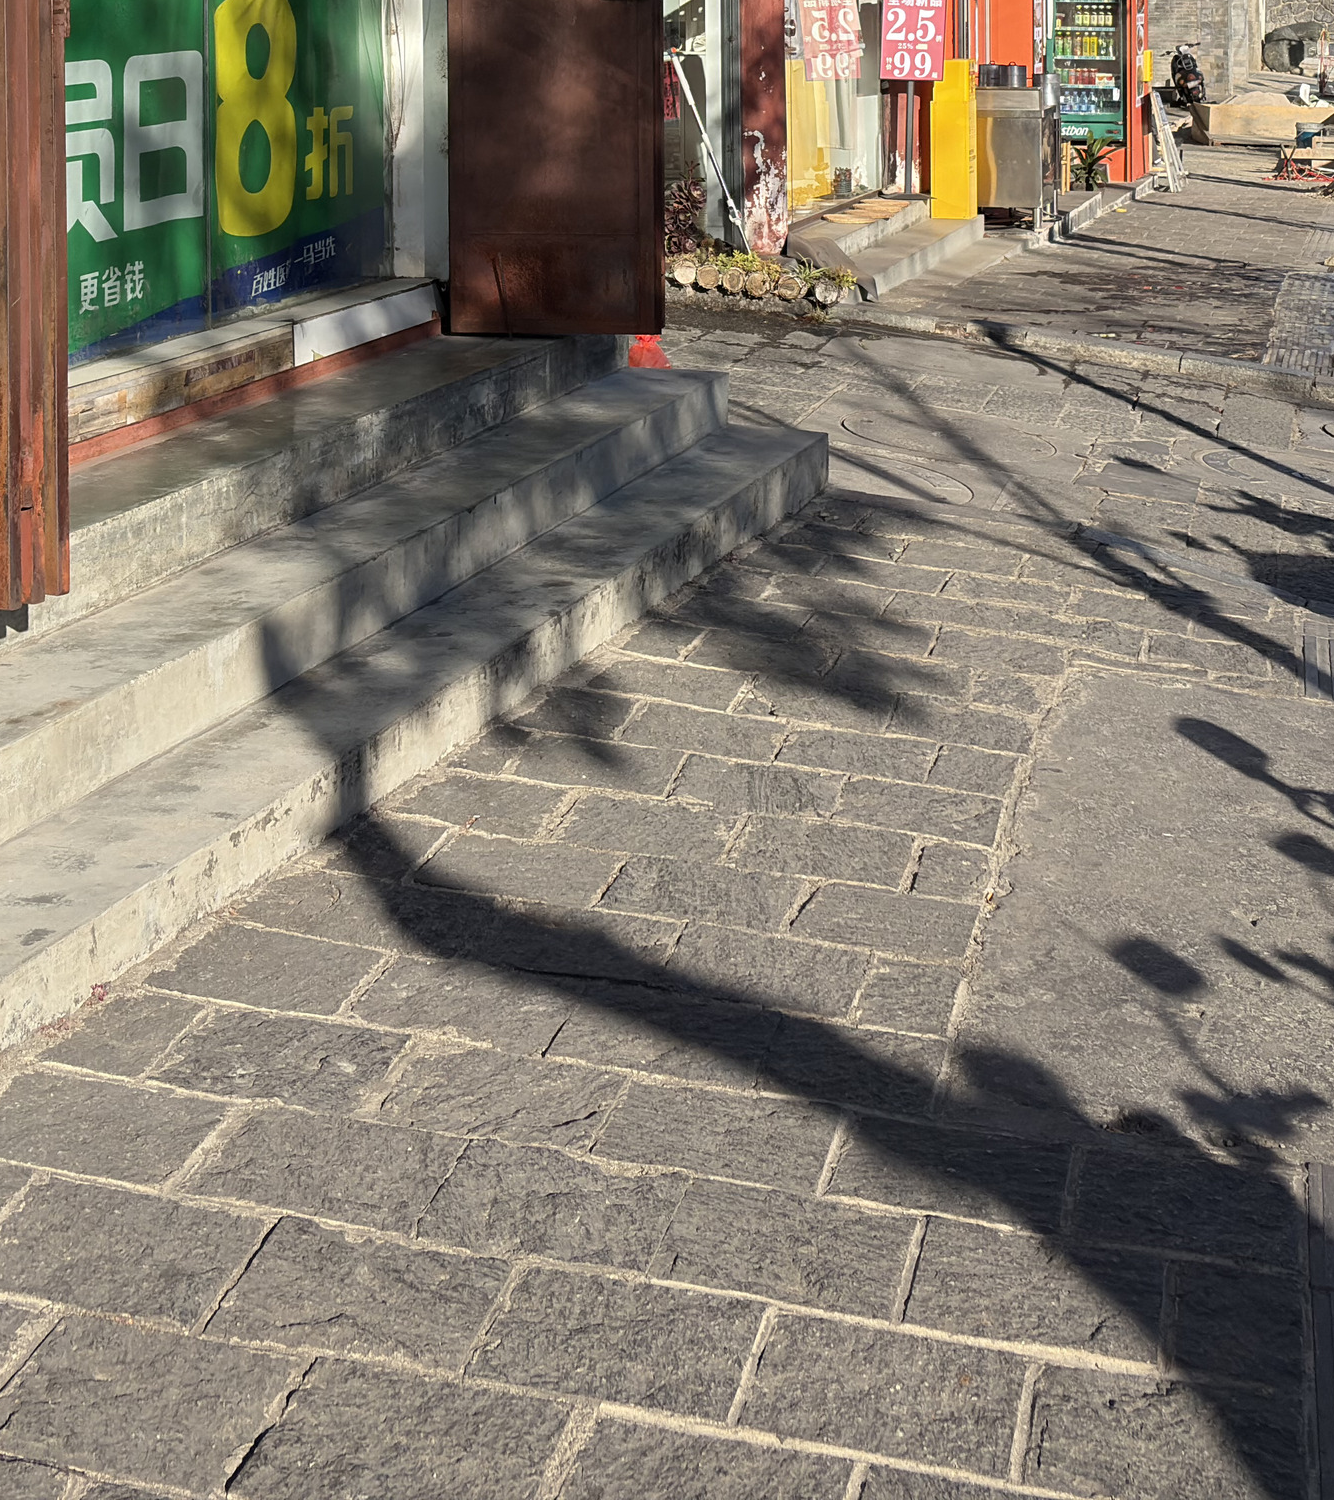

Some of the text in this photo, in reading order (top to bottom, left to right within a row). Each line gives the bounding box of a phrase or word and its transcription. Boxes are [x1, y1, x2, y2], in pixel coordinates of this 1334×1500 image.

[885, 7, 936, 42] 2.5
[893, 51, 932, 78] 99
[294, 236, 336, 265] 一马当先
[79, 260, 145, 315] 更省钱
